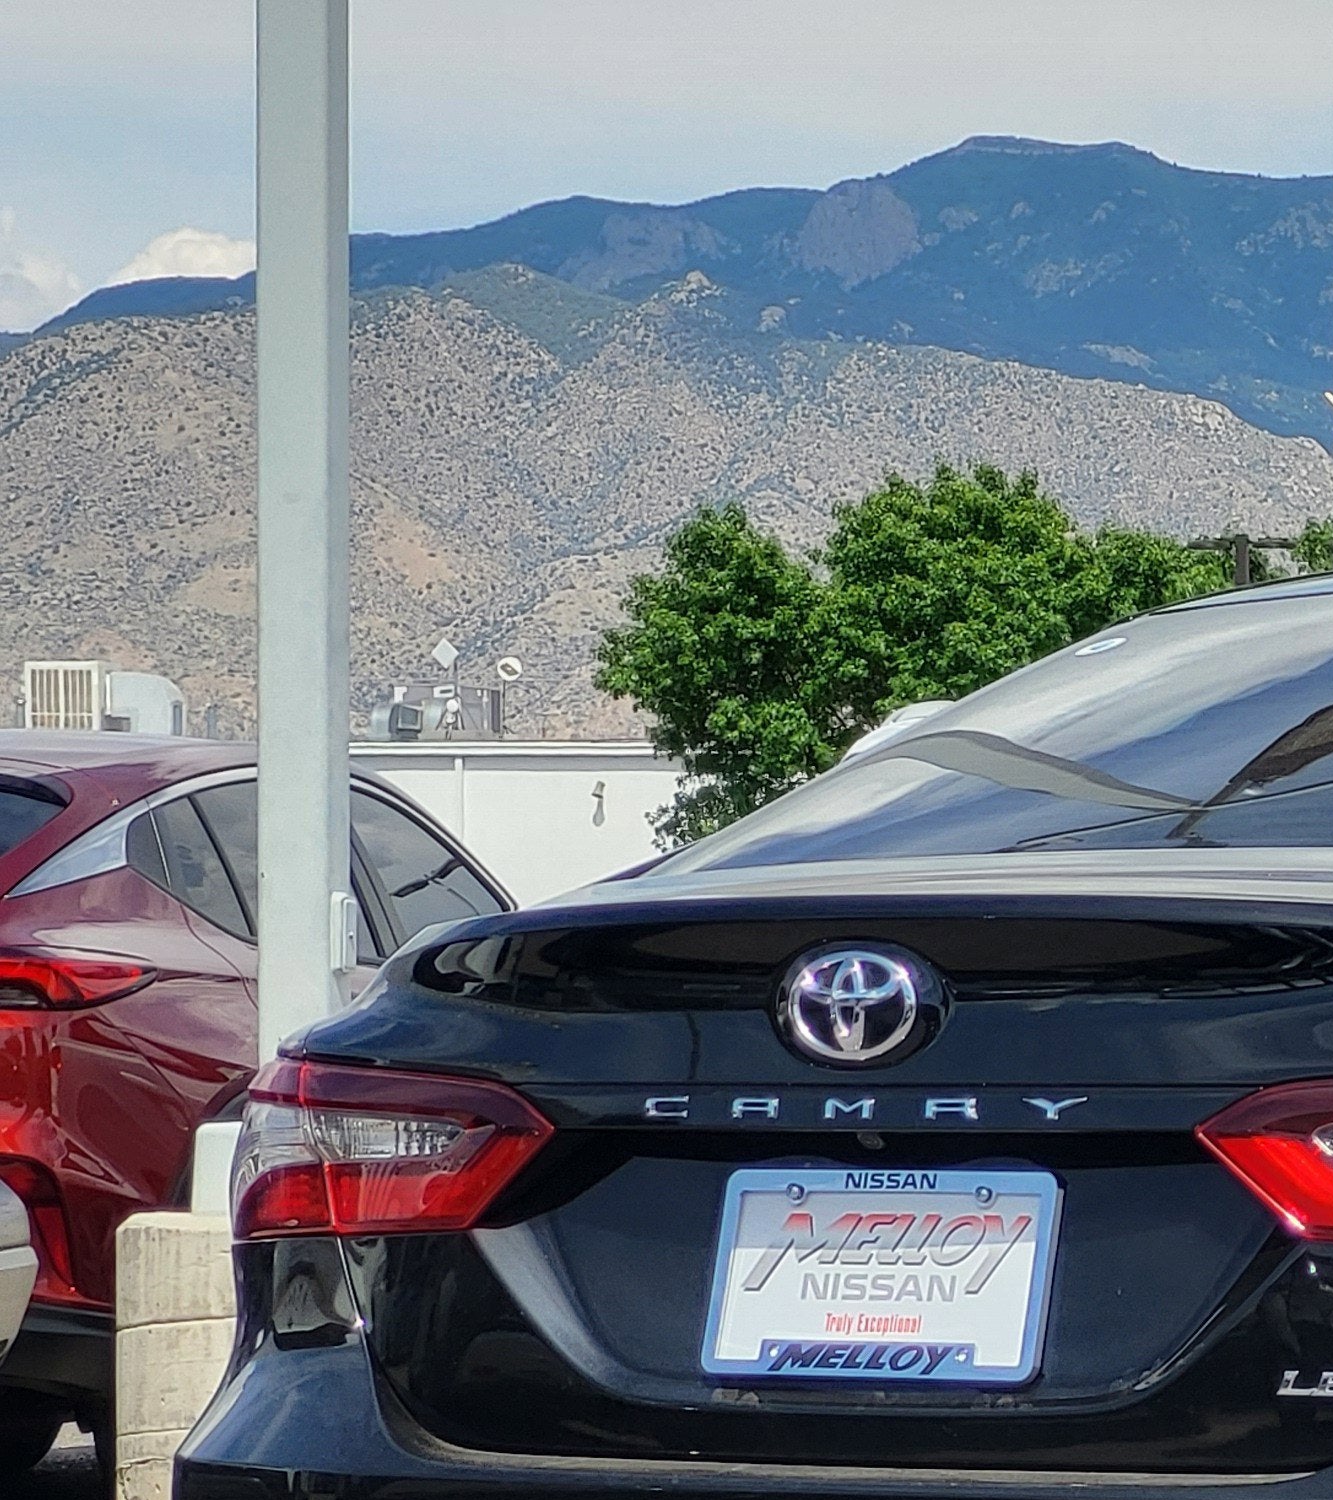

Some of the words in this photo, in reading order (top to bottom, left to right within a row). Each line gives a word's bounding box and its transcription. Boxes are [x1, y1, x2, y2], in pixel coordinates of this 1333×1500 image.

[644, 1095, 1088, 1120] CAMRY
[844, 1172, 938, 1190] NISSAN
[742, 1212, 1033, 1295] MELLOY
[800, 1272, 957, 1303] NISSAN
[825, 1313, 854, 1335] Truly
[856, 1314, 922, 1336] Exceptional
[766, 1343, 955, 1376] MELLOY
